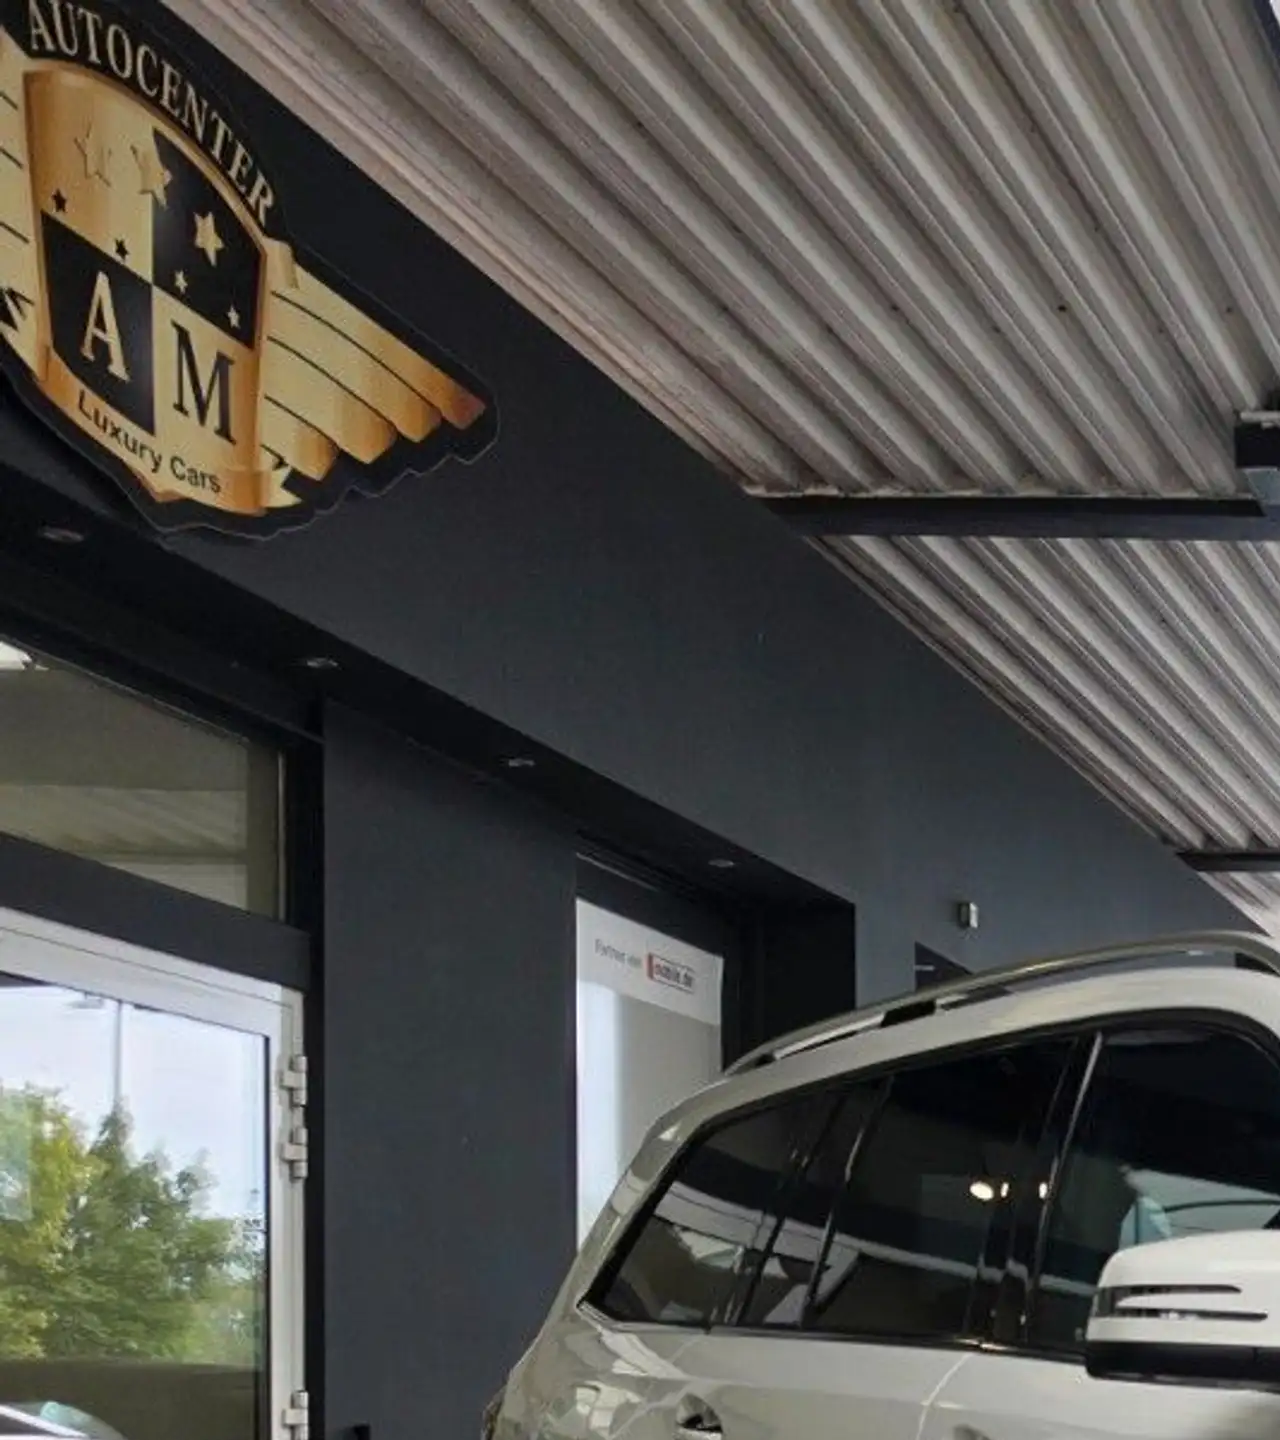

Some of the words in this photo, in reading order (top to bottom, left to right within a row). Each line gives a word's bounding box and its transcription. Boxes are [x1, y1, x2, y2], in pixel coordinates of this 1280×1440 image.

[28, 0, 274, 226] AUTOCENTER
[78, 389, 162, 473] Luxury
[170, 455, 221, 493] Cars
